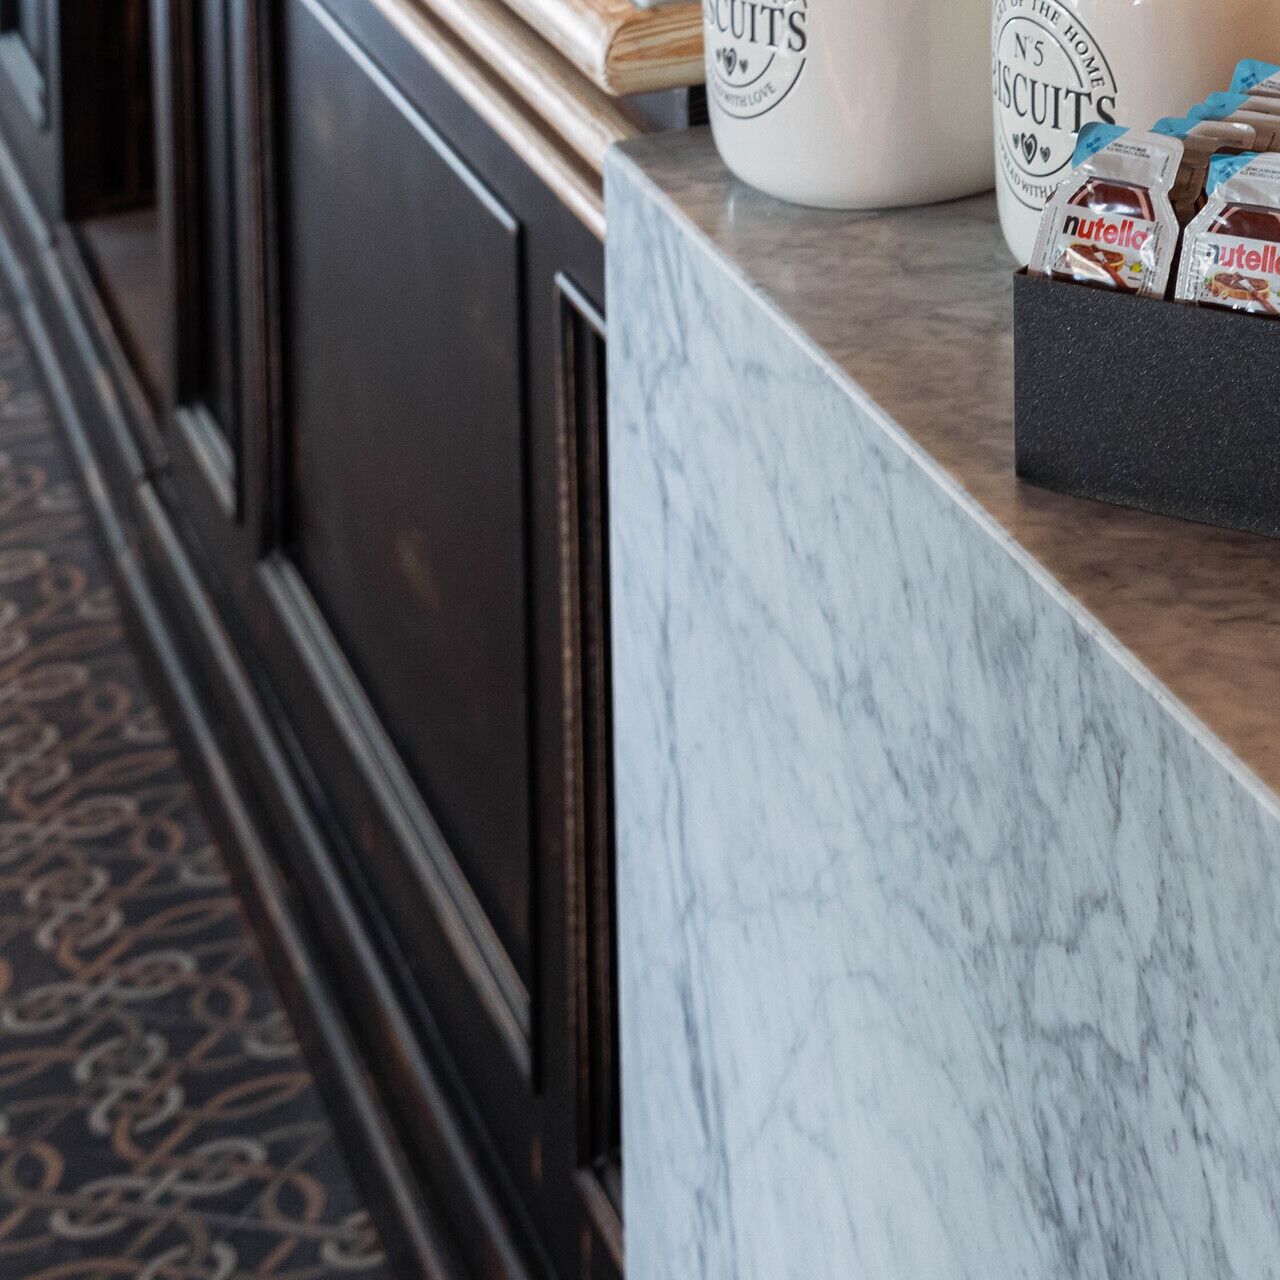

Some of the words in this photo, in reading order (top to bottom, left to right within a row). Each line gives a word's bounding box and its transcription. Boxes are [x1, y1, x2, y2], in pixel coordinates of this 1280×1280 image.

[1063, 24, 1105, 89] HOME
[750, 81, 777, 108] LOVE
[1022, 177, 1049, 200] WITH
[1062, 215, 1151, 251] nutella
